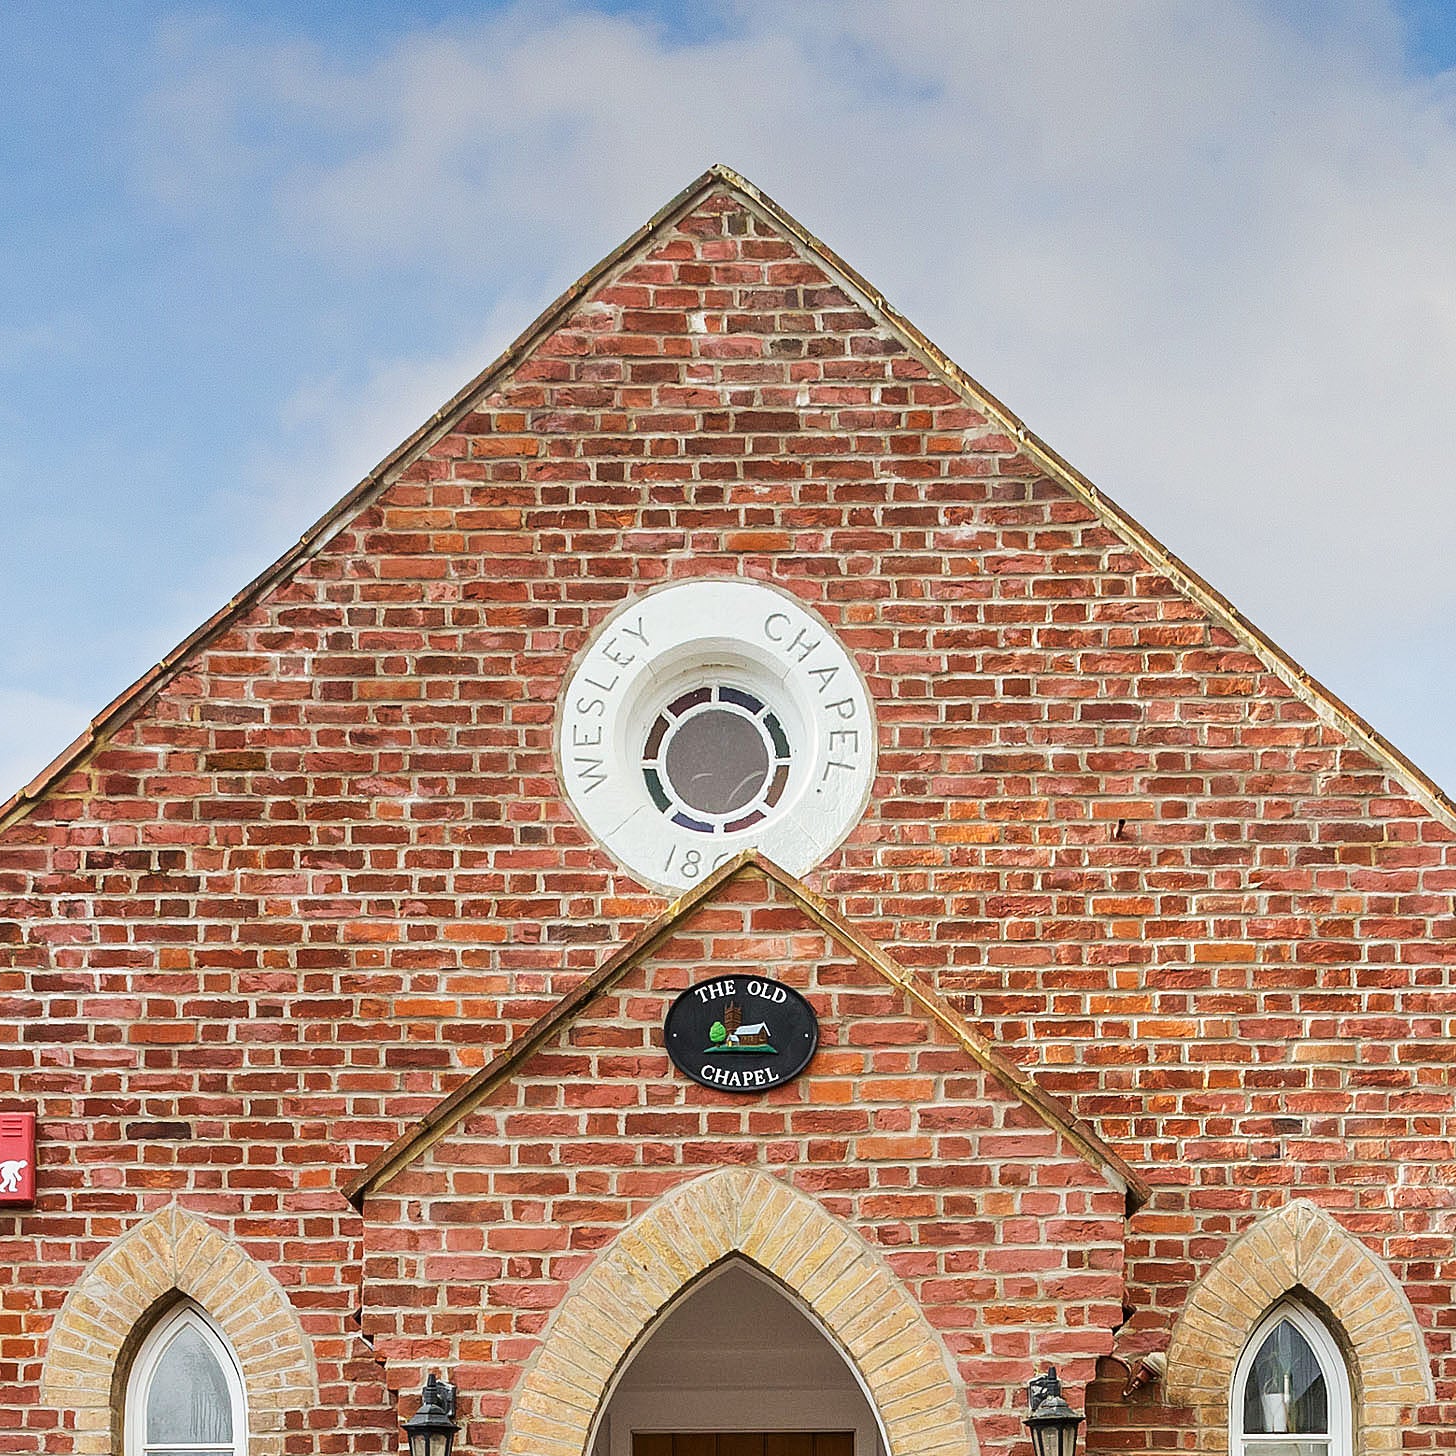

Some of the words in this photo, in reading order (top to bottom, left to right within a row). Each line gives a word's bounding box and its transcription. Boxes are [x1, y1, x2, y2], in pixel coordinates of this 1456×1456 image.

[573, 616, 651, 794] WESLEY
[694, 979, 737, 1004] THE
[746, 980, 788, 1004] OLD
[700, 1064, 780, 1087] CHAPEL
